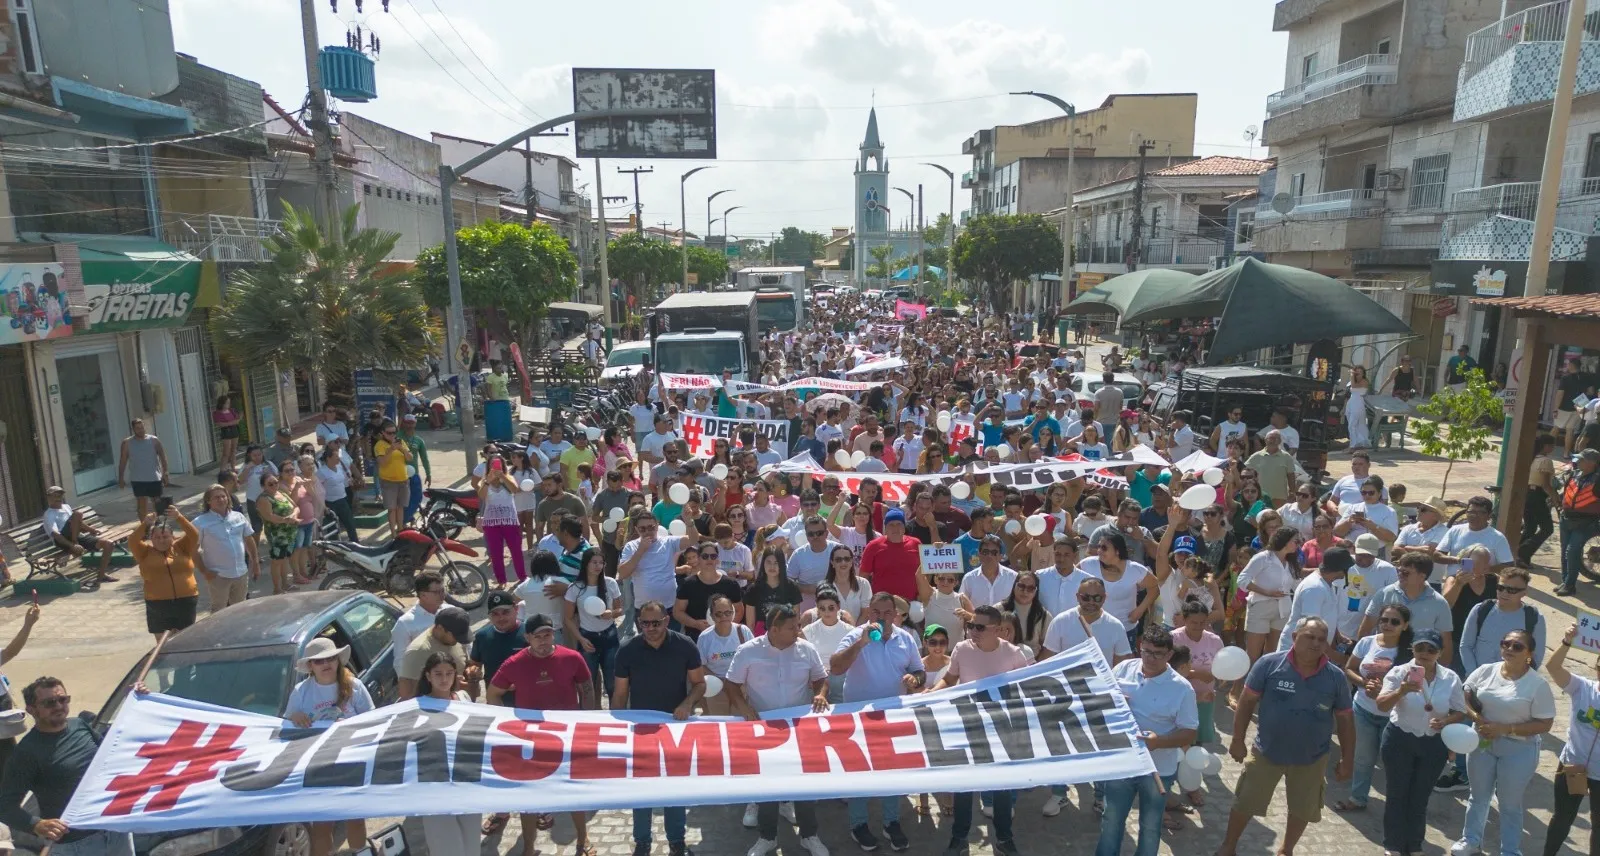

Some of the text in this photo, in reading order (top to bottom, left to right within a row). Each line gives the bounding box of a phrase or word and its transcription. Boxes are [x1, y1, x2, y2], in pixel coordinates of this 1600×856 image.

[102, 292, 191, 323] FREITAS
[933, 548, 956, 557] JERI
[928, 561, 958, 571] LIVRE
[1278, 680, 1295, 689] 692
